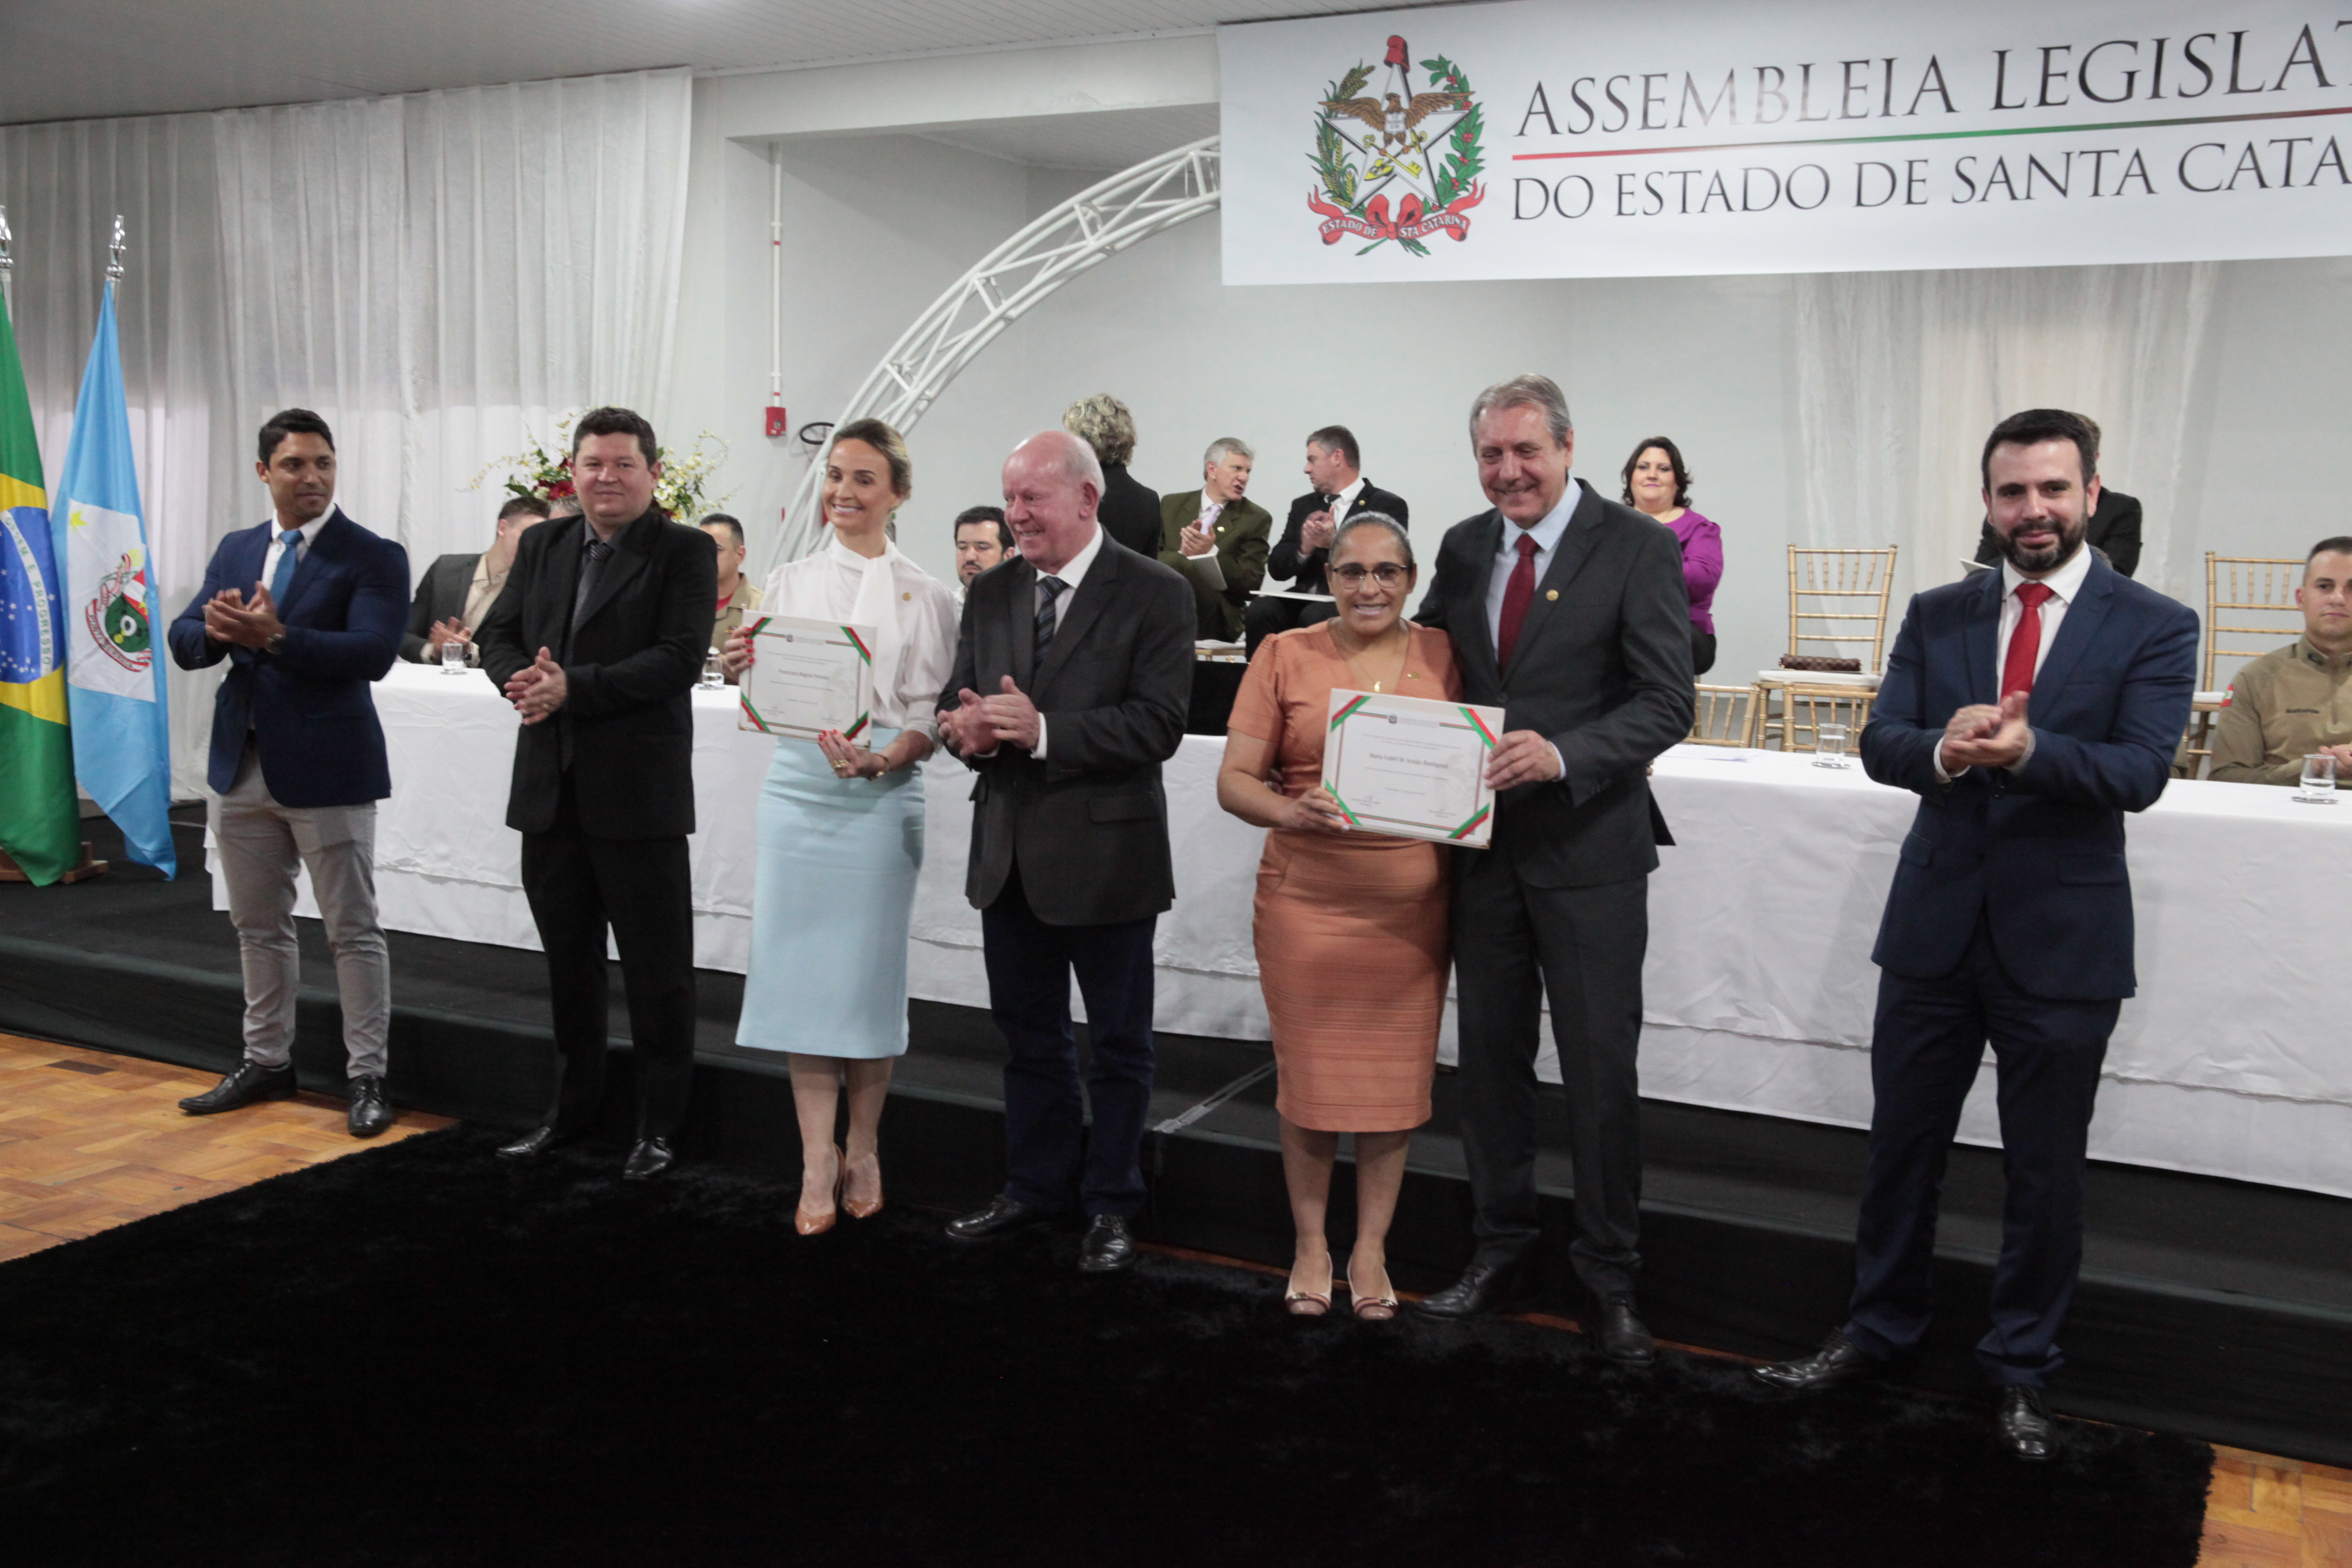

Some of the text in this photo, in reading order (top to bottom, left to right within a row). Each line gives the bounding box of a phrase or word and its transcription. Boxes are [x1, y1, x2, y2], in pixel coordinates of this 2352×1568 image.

[1512, 54, 1961, 137] ASSEMBLEIA
[1512, 135, 2352, 221] DO ESTADO DE SANTA CATA
[1322, 219, 1363, 234] ESTADO
[1363, 225, 1378, 238] DE
[1420, 214, 1467, 233] CATARINA
[27, 564, 36, 573] E
[32, 581, 51, 665] PROGRESSO
